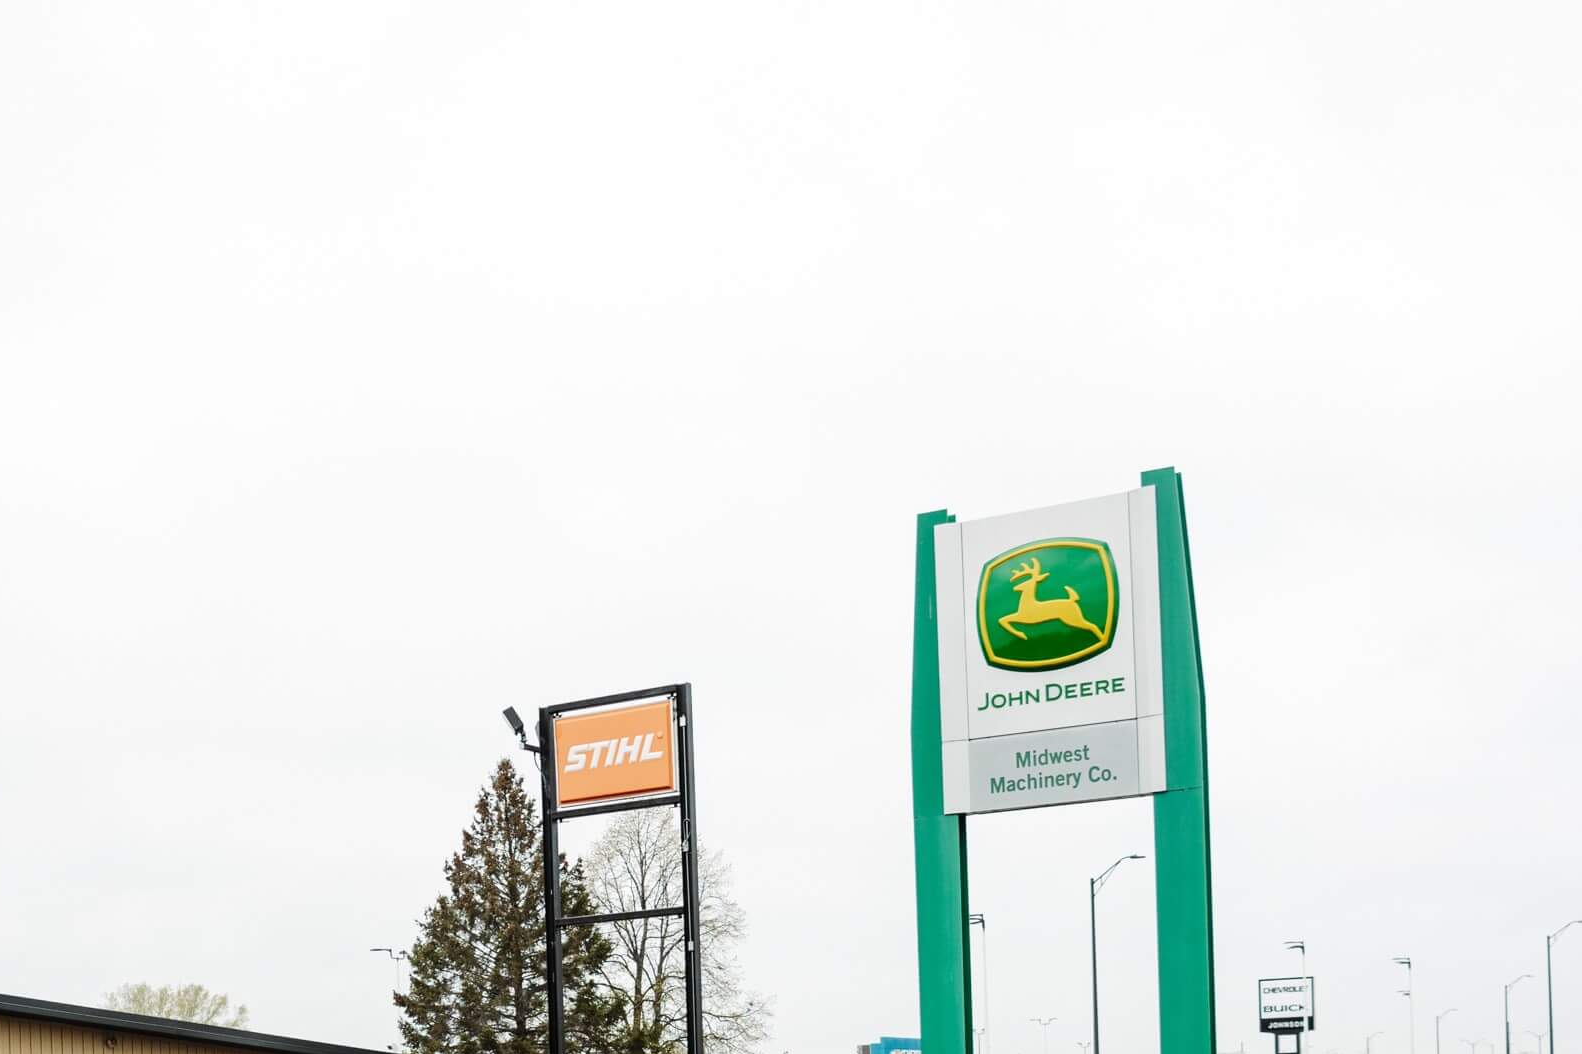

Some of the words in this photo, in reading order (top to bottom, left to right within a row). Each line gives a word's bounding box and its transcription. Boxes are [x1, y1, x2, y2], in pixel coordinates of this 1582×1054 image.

[978, 688, 1040, 711] JOHN
[1045, 677, 1126, 702] DEERE
[564, 733, 664, 773] STIHL
[1015, 745, 1090, 768] Midwest
[990, 771, 1082, 794] Machinery
[1088, 766, 1117, 783] Co.
